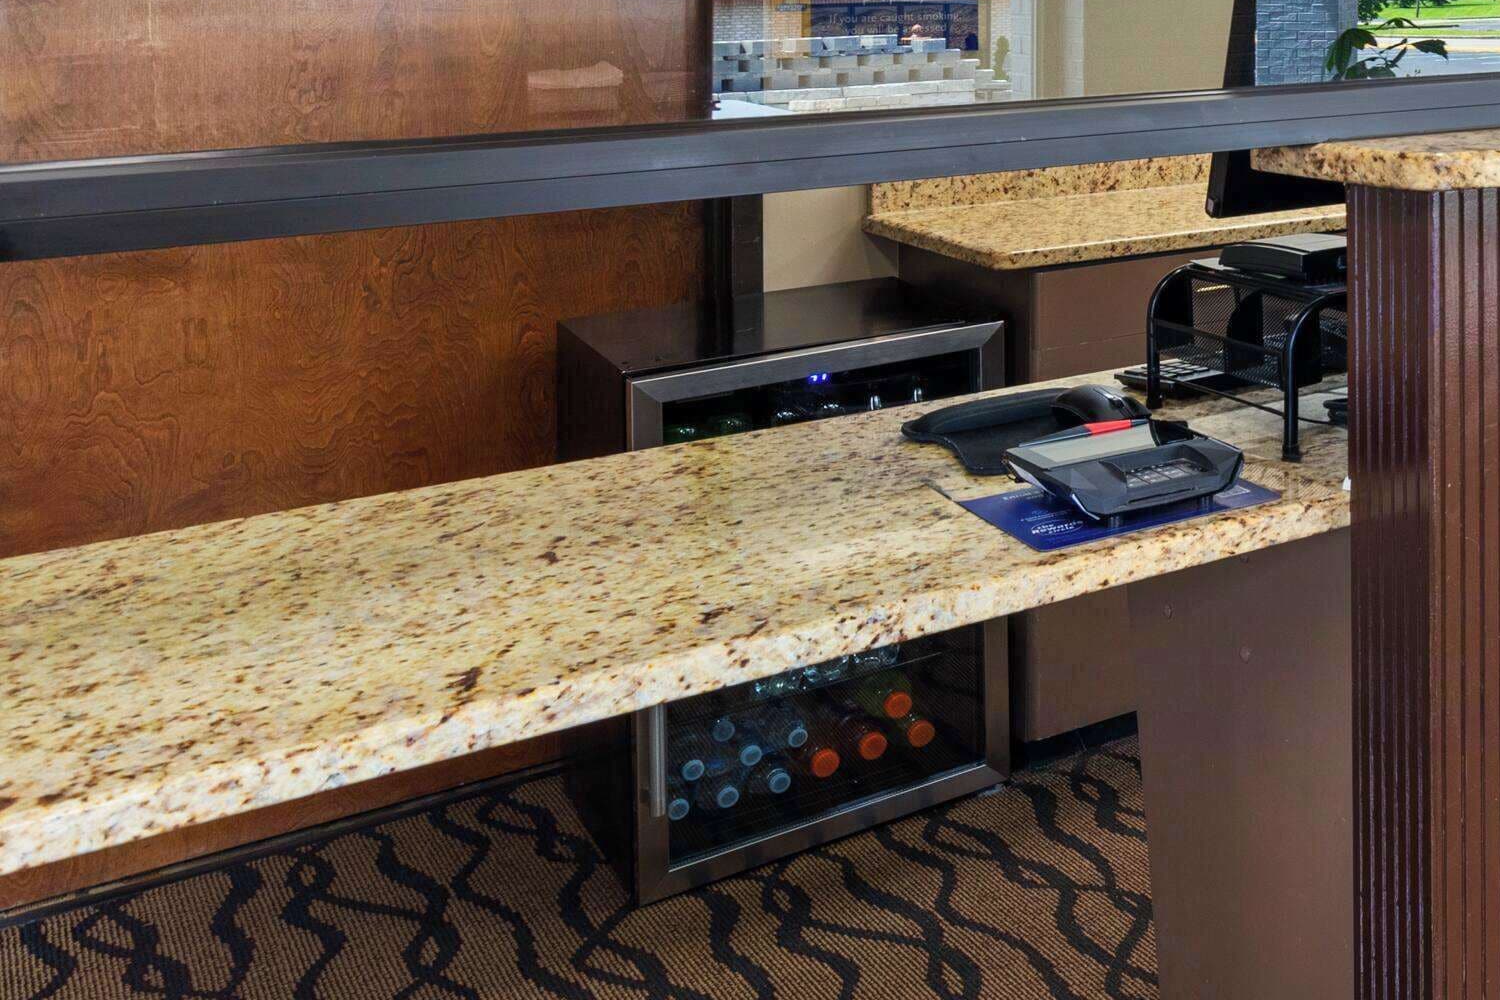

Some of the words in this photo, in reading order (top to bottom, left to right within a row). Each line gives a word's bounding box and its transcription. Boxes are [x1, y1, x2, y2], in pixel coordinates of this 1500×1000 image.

[829, 14, 840, 24] If
[839, 15, 859, 26] you
[860, 15, 878, 23] are
[879, 10, 914, 24] caught
[845, 27, 865, 36] you
[866, 24, 886, 35] will
[887, 24, 899, 34] be
